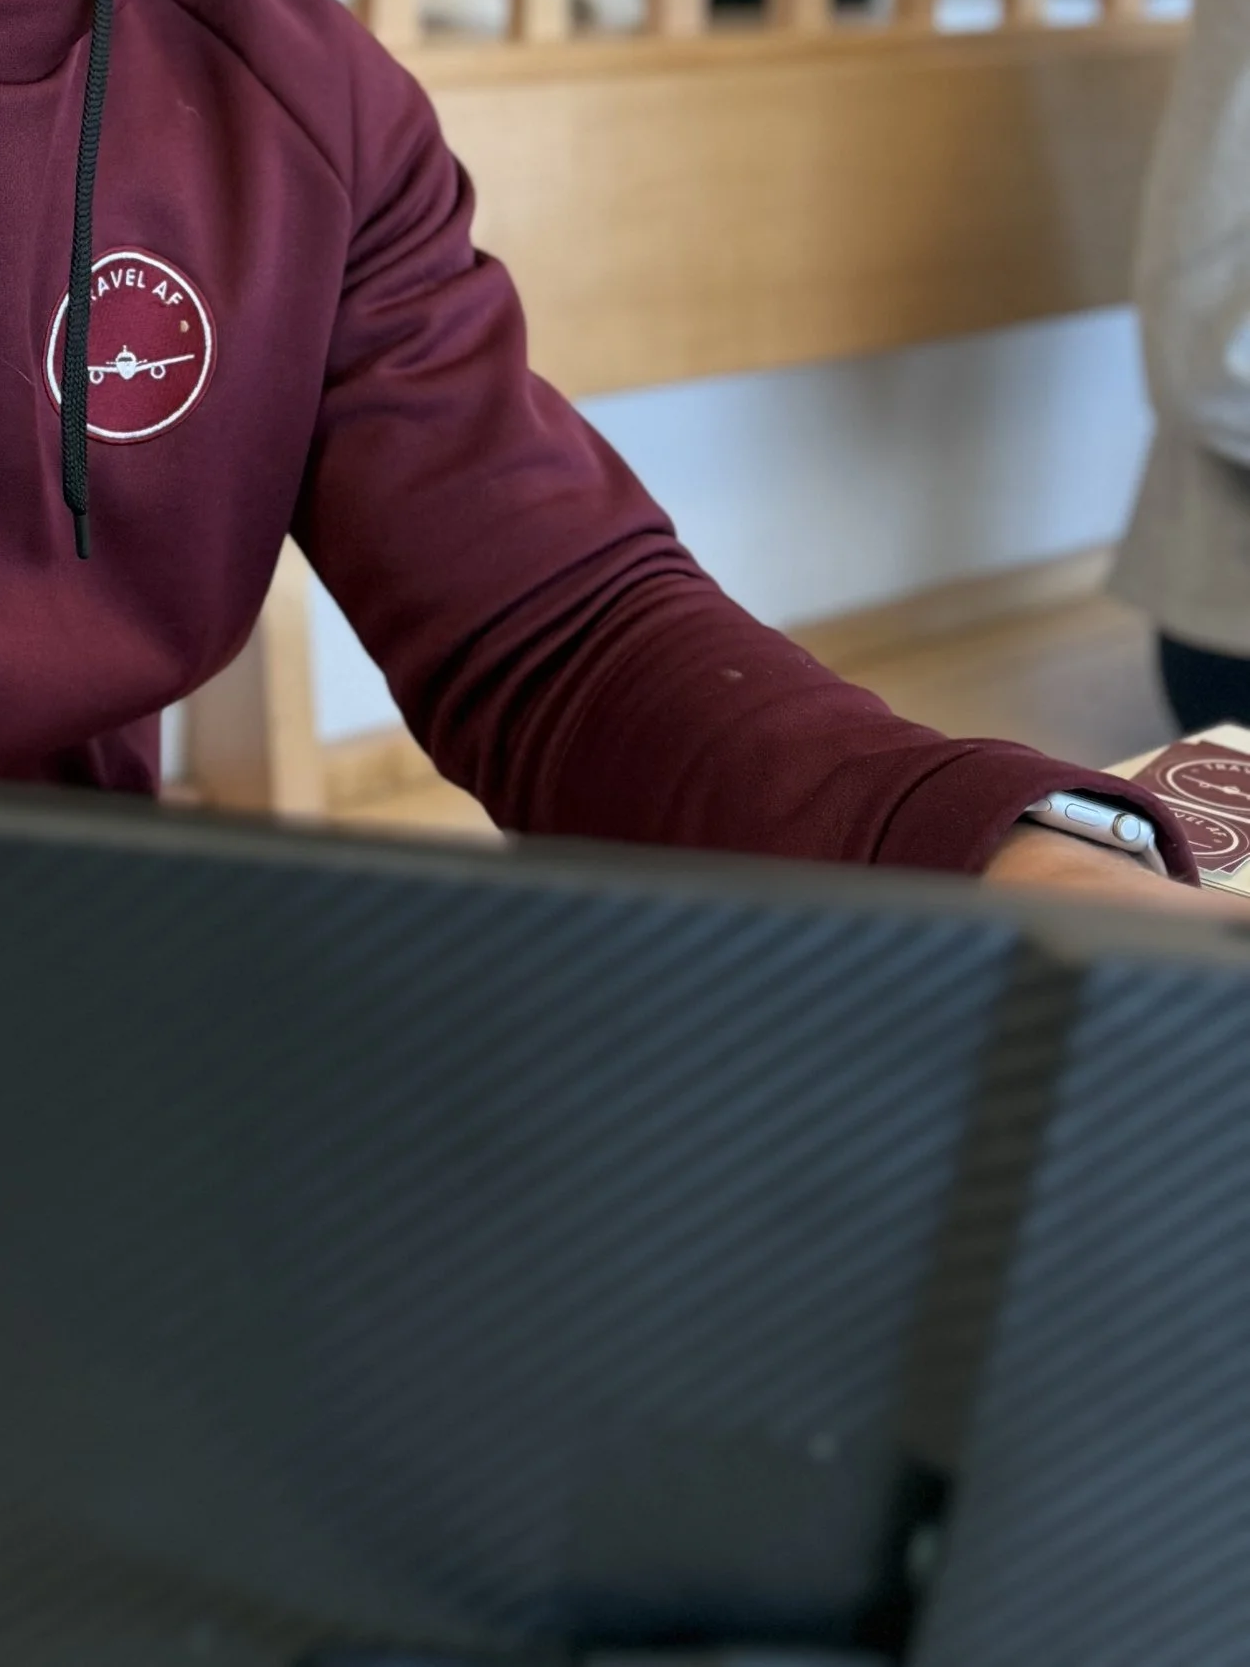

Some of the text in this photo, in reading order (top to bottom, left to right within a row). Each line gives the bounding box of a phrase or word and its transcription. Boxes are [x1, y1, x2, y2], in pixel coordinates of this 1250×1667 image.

[91, 268, 184, 305] AVEL AF
[1174, 811, 1204, 825] VEL
